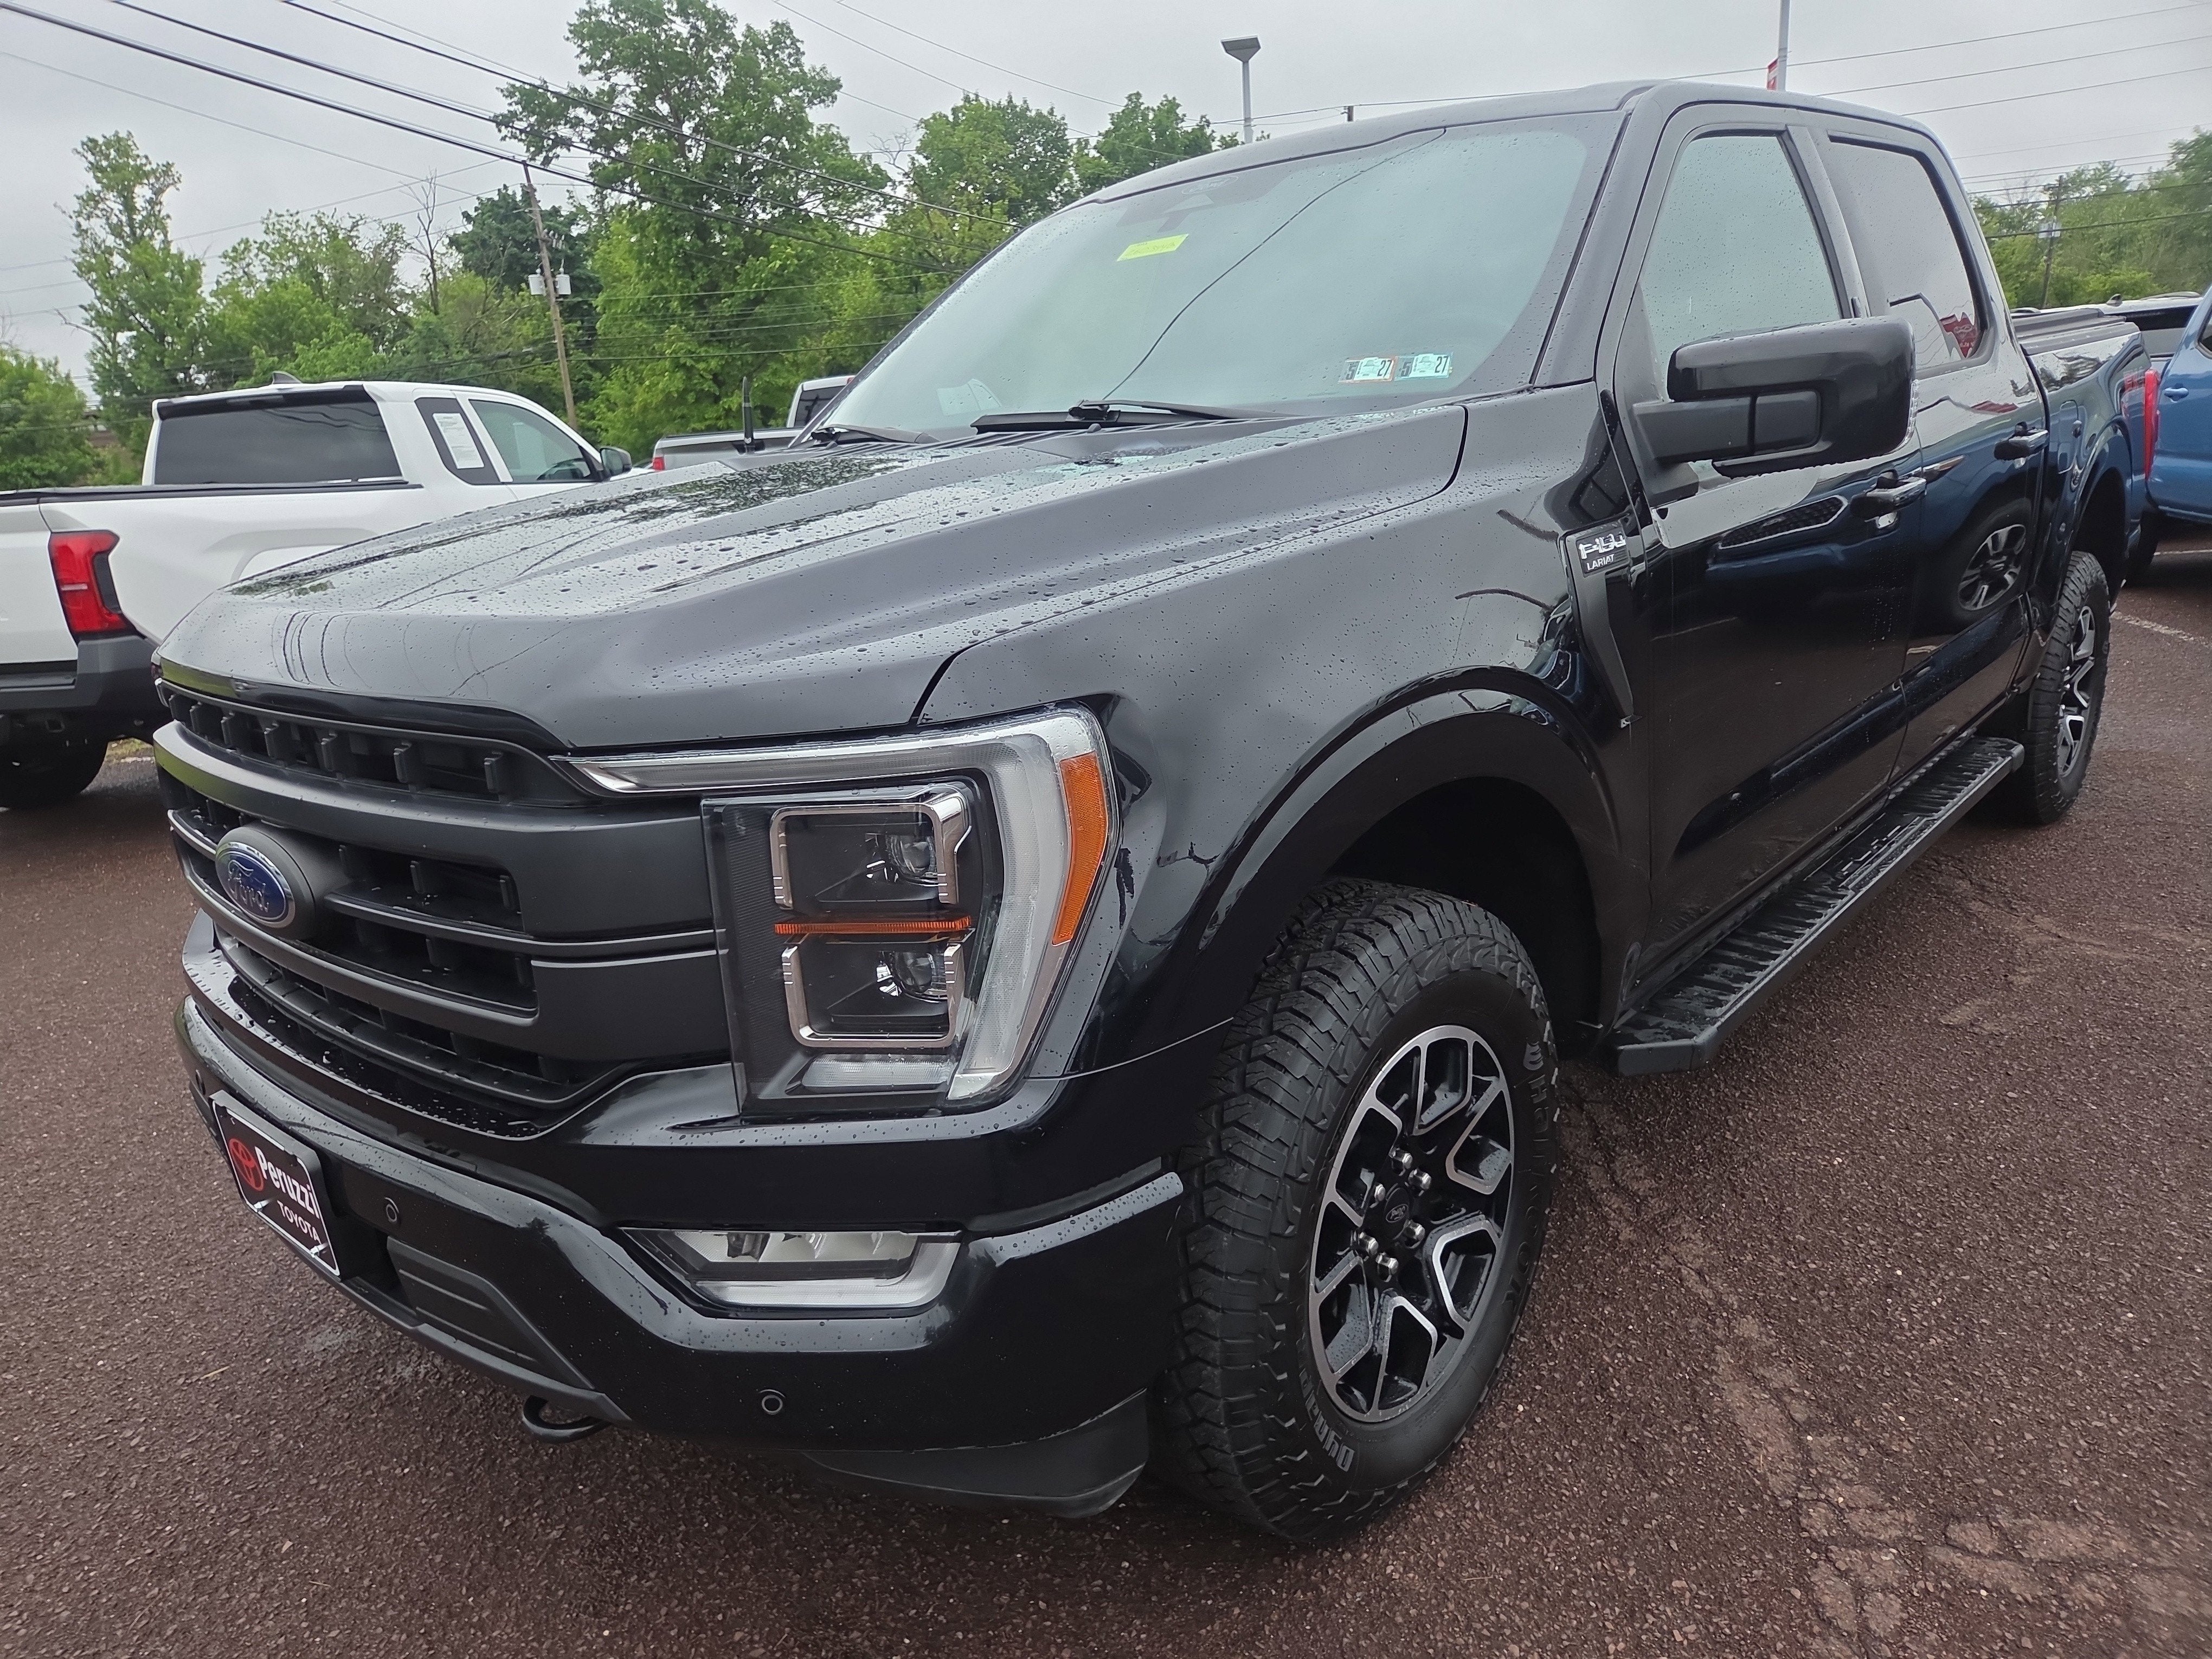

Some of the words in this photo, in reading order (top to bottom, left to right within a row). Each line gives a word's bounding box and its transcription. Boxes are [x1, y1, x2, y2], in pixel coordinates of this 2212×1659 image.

[1378, 360, 1392, 377] 27
[1401, 362, 1411, 377] 5
[1435, 356, 1449, 374] 27
[1586, 554, 1615, 571] LARIAT
[254, 1146, 320, 1219] Peruzzi
[277, 1200, 322, 1245] TOYOTA
